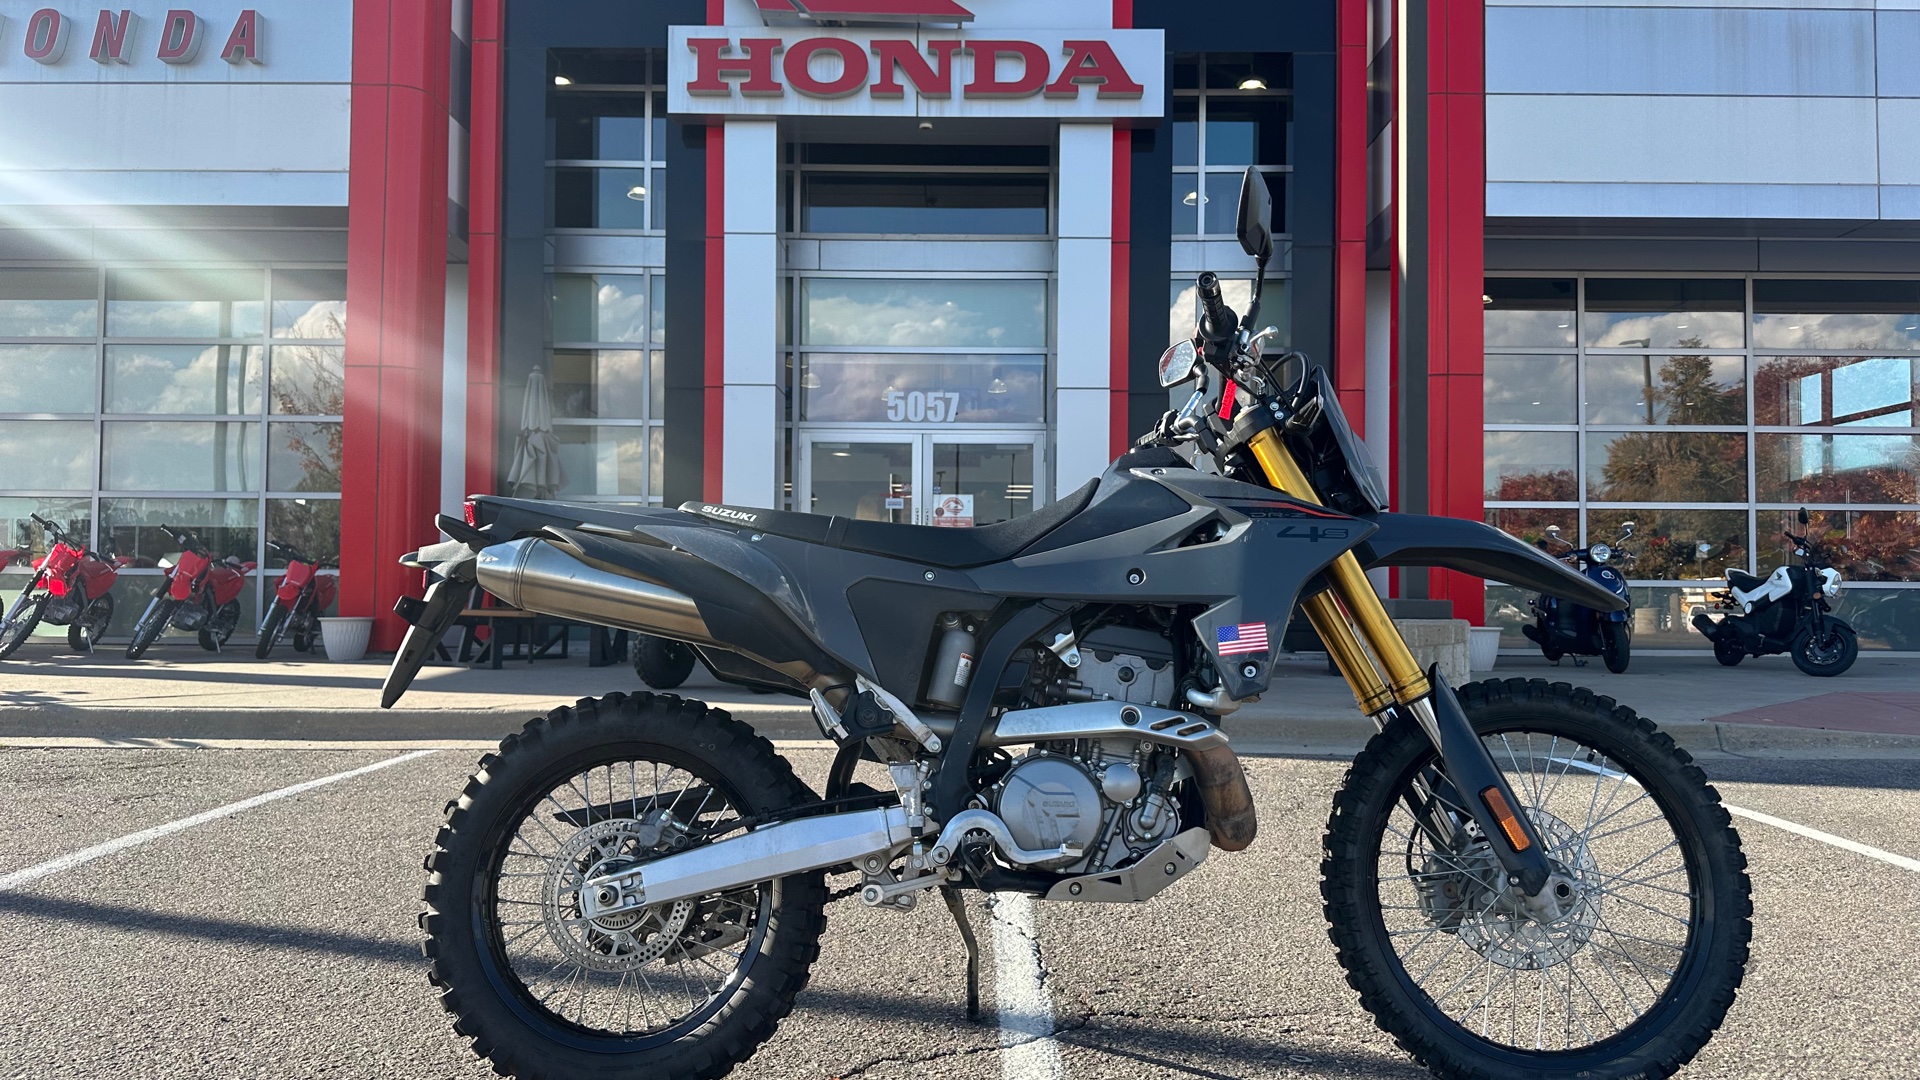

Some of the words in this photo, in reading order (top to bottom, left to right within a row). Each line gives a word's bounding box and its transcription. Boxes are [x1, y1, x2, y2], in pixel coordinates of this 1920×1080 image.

[0, 8, 264, 65] ONDA
[686, 37, 1144, 99] HONDA
[887, 391, 960, 422] 5057
[701, 505, 758, 522] SUZUKI
[1276, 526, 1349, 542] 4S
